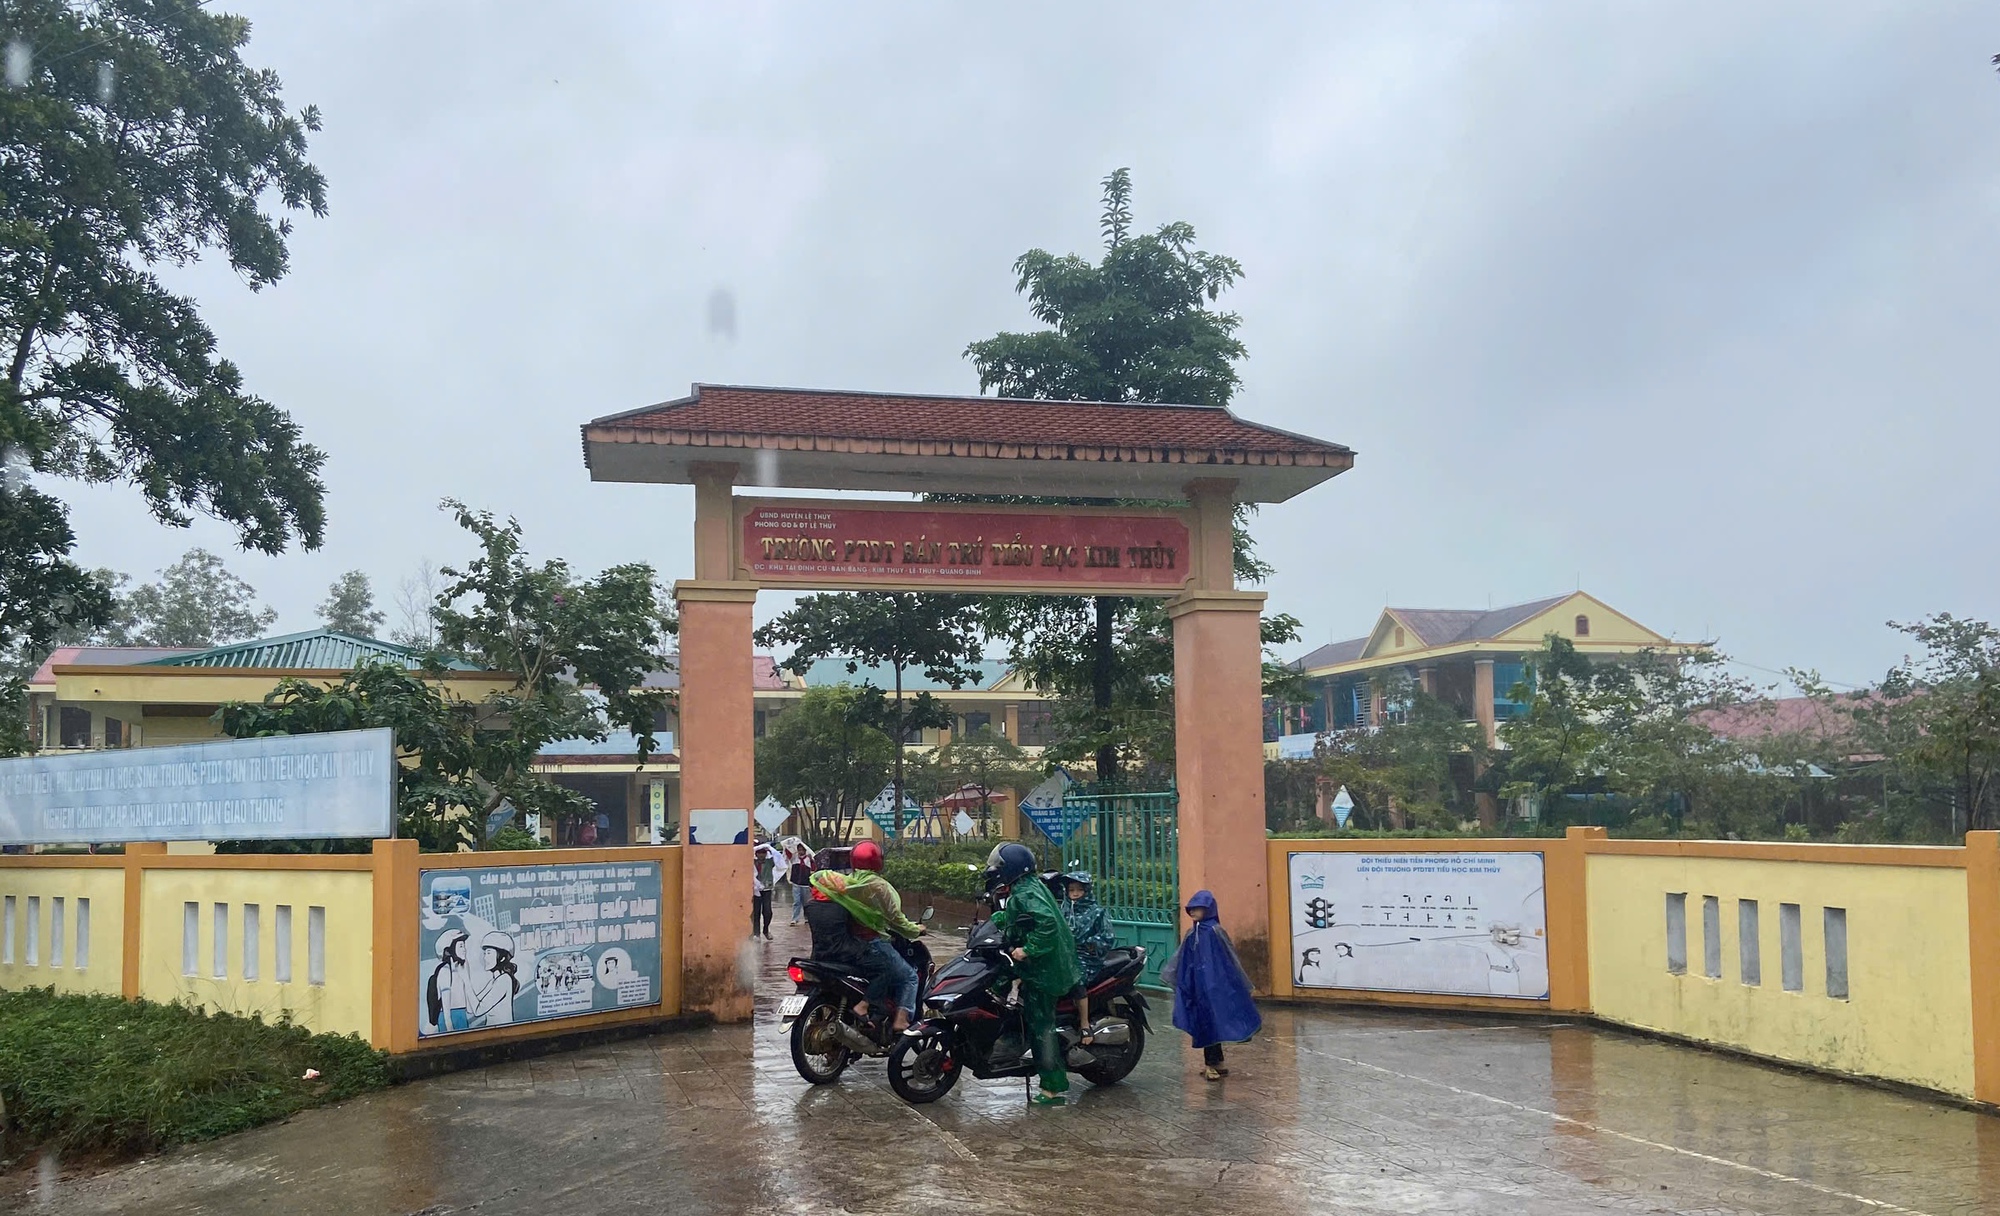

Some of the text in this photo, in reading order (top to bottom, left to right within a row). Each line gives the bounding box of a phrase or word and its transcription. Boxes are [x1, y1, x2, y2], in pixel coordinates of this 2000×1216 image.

[760, 533, 836, 562] TRƯỜNG
[843, 540, 896, 564] PTDT
[900, 534, 942, 564] BÁN
[947, 535, 984, 565] TRÚ
[991, 532, 1034, 566] TIỂU
[1041, 544, 1078, 571] HỌC
[1084, 545, 1120, 568] KIM
[138, 766, 158, 788] SINH
[200, 761, 222, 784] PTDT
[296, 753, 319, 784] HỌC
[181, 801, 194, 827] AN
[224, 800, 247, 824] GIAO
